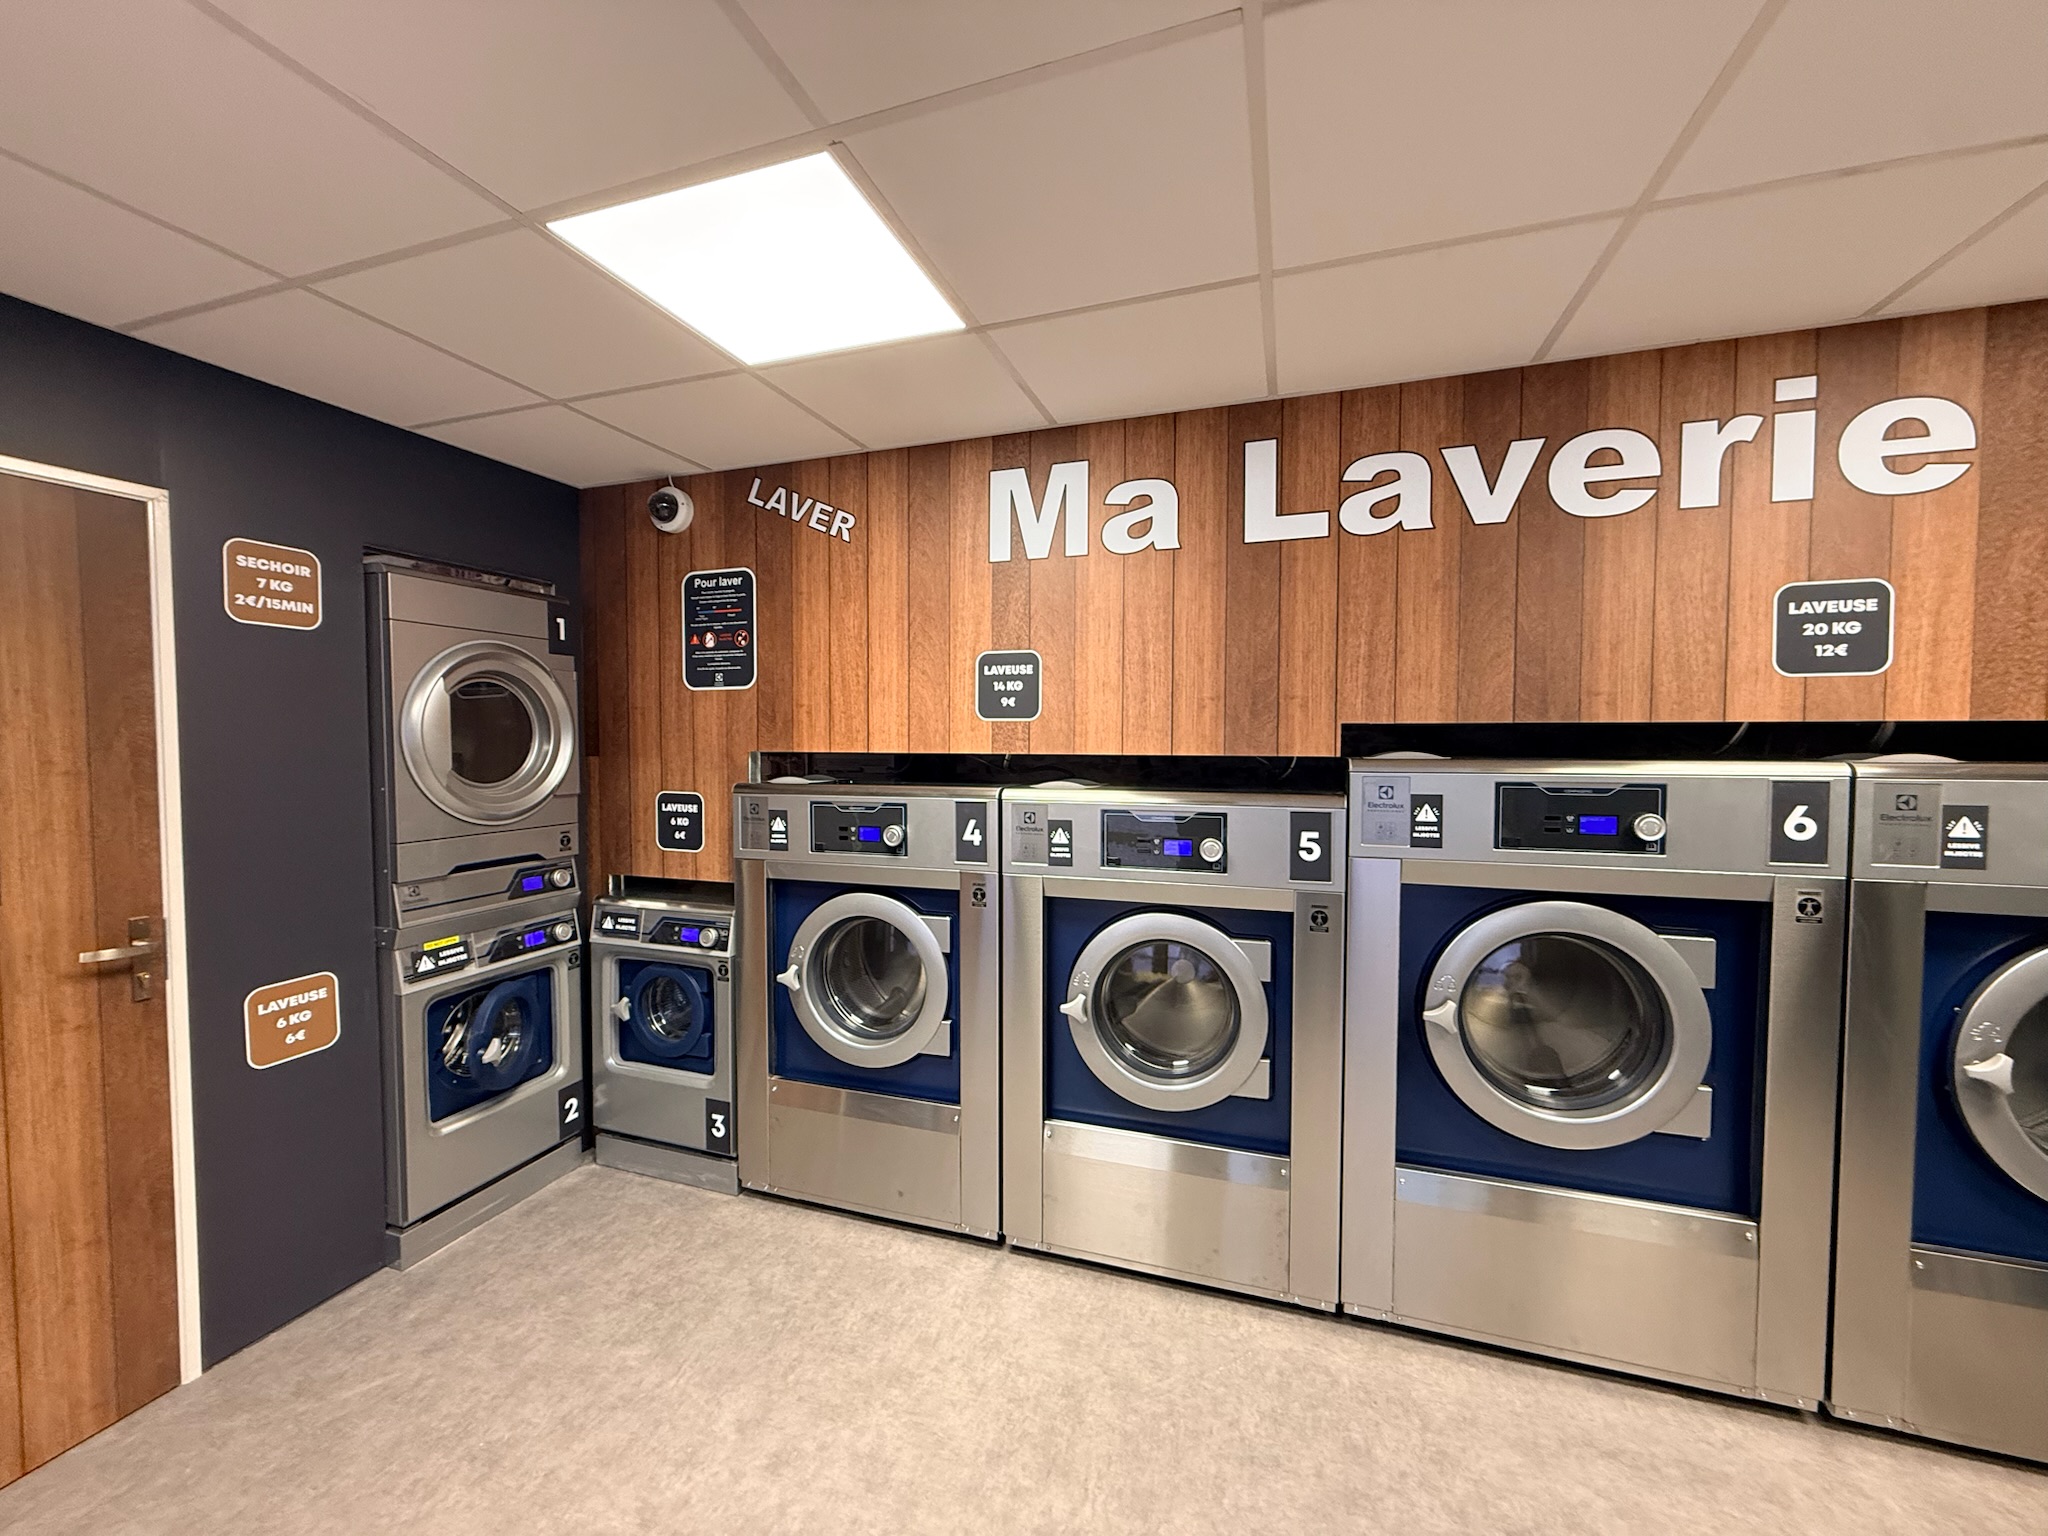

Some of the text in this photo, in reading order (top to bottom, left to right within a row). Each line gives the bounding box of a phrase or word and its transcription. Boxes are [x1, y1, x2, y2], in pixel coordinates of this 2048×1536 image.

[987, 374, 1978, 564] Ma Laverie
[747, 477, 856, 543] LAVER
[235, 554, 312, 578] SECHOIR
[256, 577, 294, 593] 7 KG
[693, 575, 744, 589] Pour laver
[234, 593, 315, 615] 2€/15MIN
[1787, 598, 1879, 615] LAVEUSE
[555, 617, 566, 641] 1
[1802, 620, 1863, 636] 20 KG
[1814, 643, 1849, 657] 12€
[983, 664, 1034, 676] LAVEUSE
[992, 680, 1024, 692] 14 KG
[1000, 696, 1016, 707] 9€
[661, 803, 699, 814] LAVEUSE
[1367, 801, 1405, 809] Electrolux
[670, 817, 690, 827] 6 KG
[1782, 805, 1819, 842] 6
[674, 830, 686, 840] 6€
[961, 818, 983, 847] 4
[1298, 831, 1322, 863] 5
[257, 987, 328, 1016] LAVEUSE
[276, 1010, 312, 1029] 6 KG
[285, 1030, 305, 1044] 6€
[563, 1097, 579, 1124] 2
[710, 1113, 727, 1138] 3
